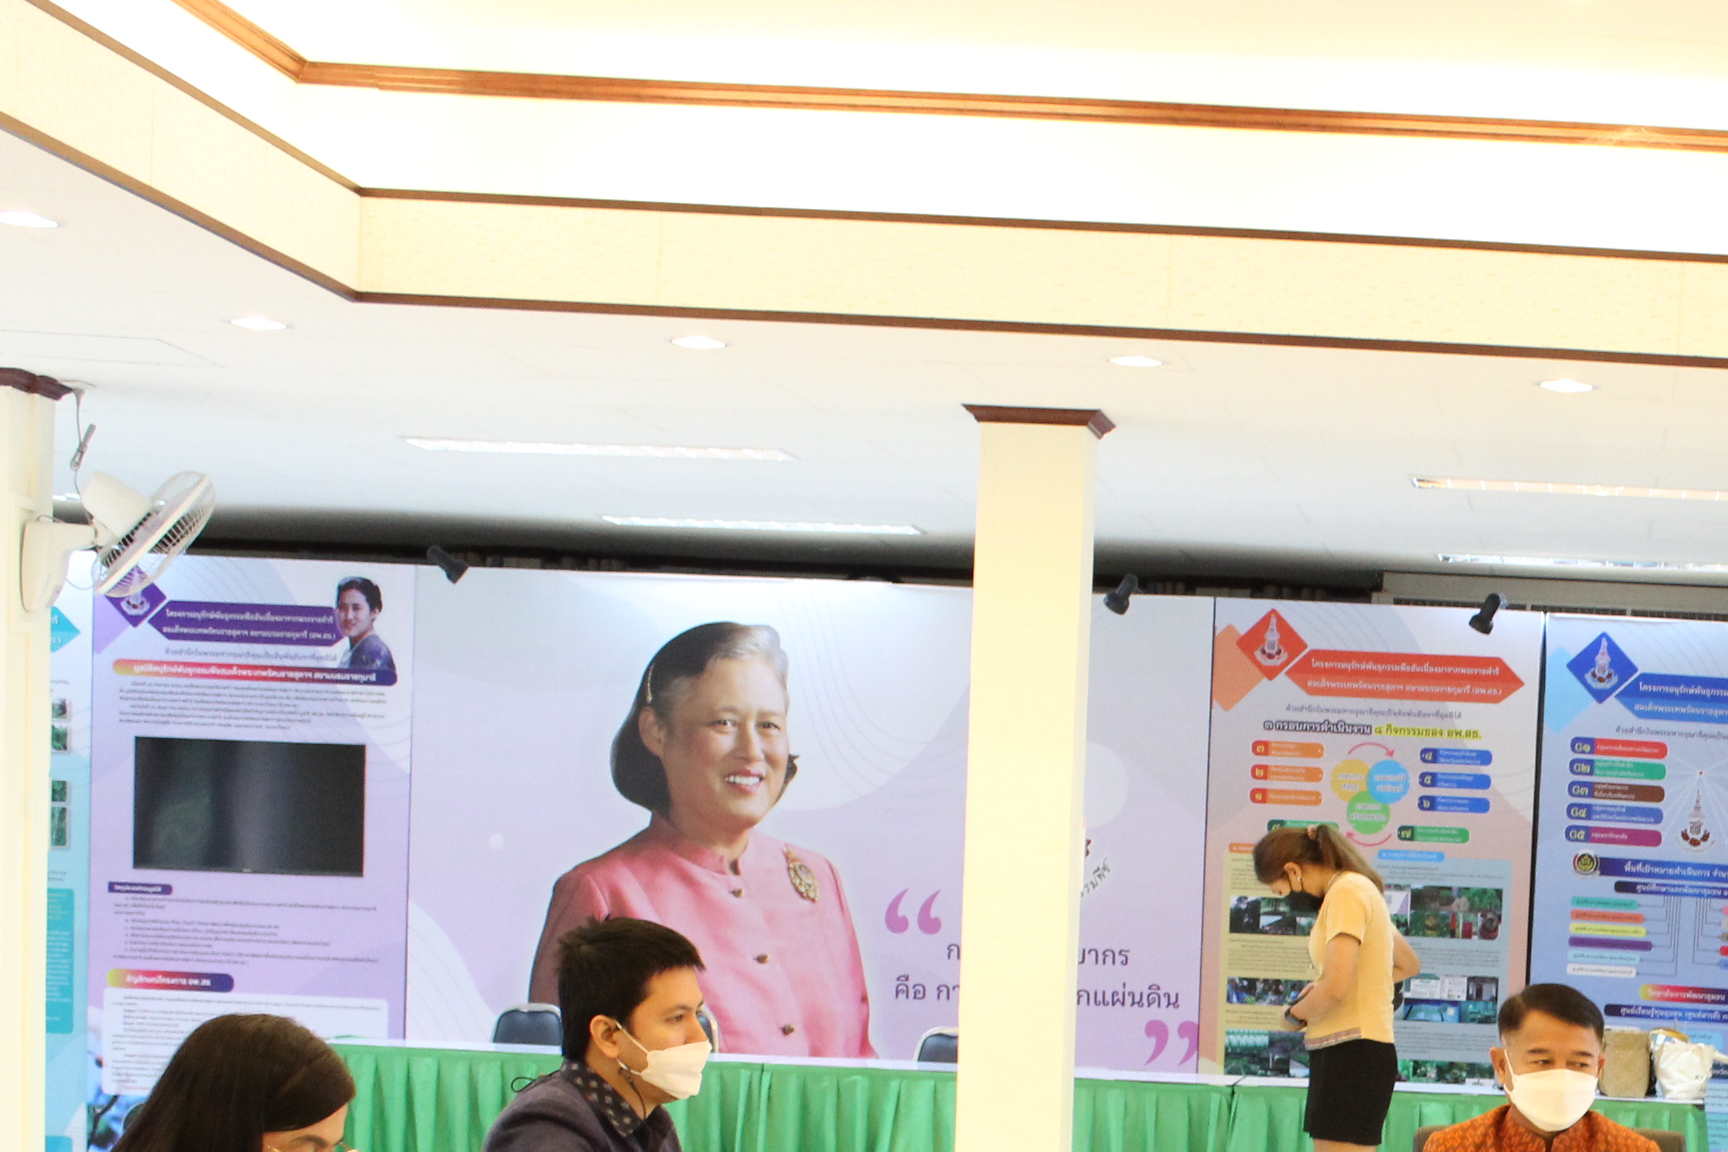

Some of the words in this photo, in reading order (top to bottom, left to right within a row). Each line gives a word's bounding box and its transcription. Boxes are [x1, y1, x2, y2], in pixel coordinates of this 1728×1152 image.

[895, 975, 926, 1001] คือ
[1077, 981, 1180, 1010] กแผ่นดิน
